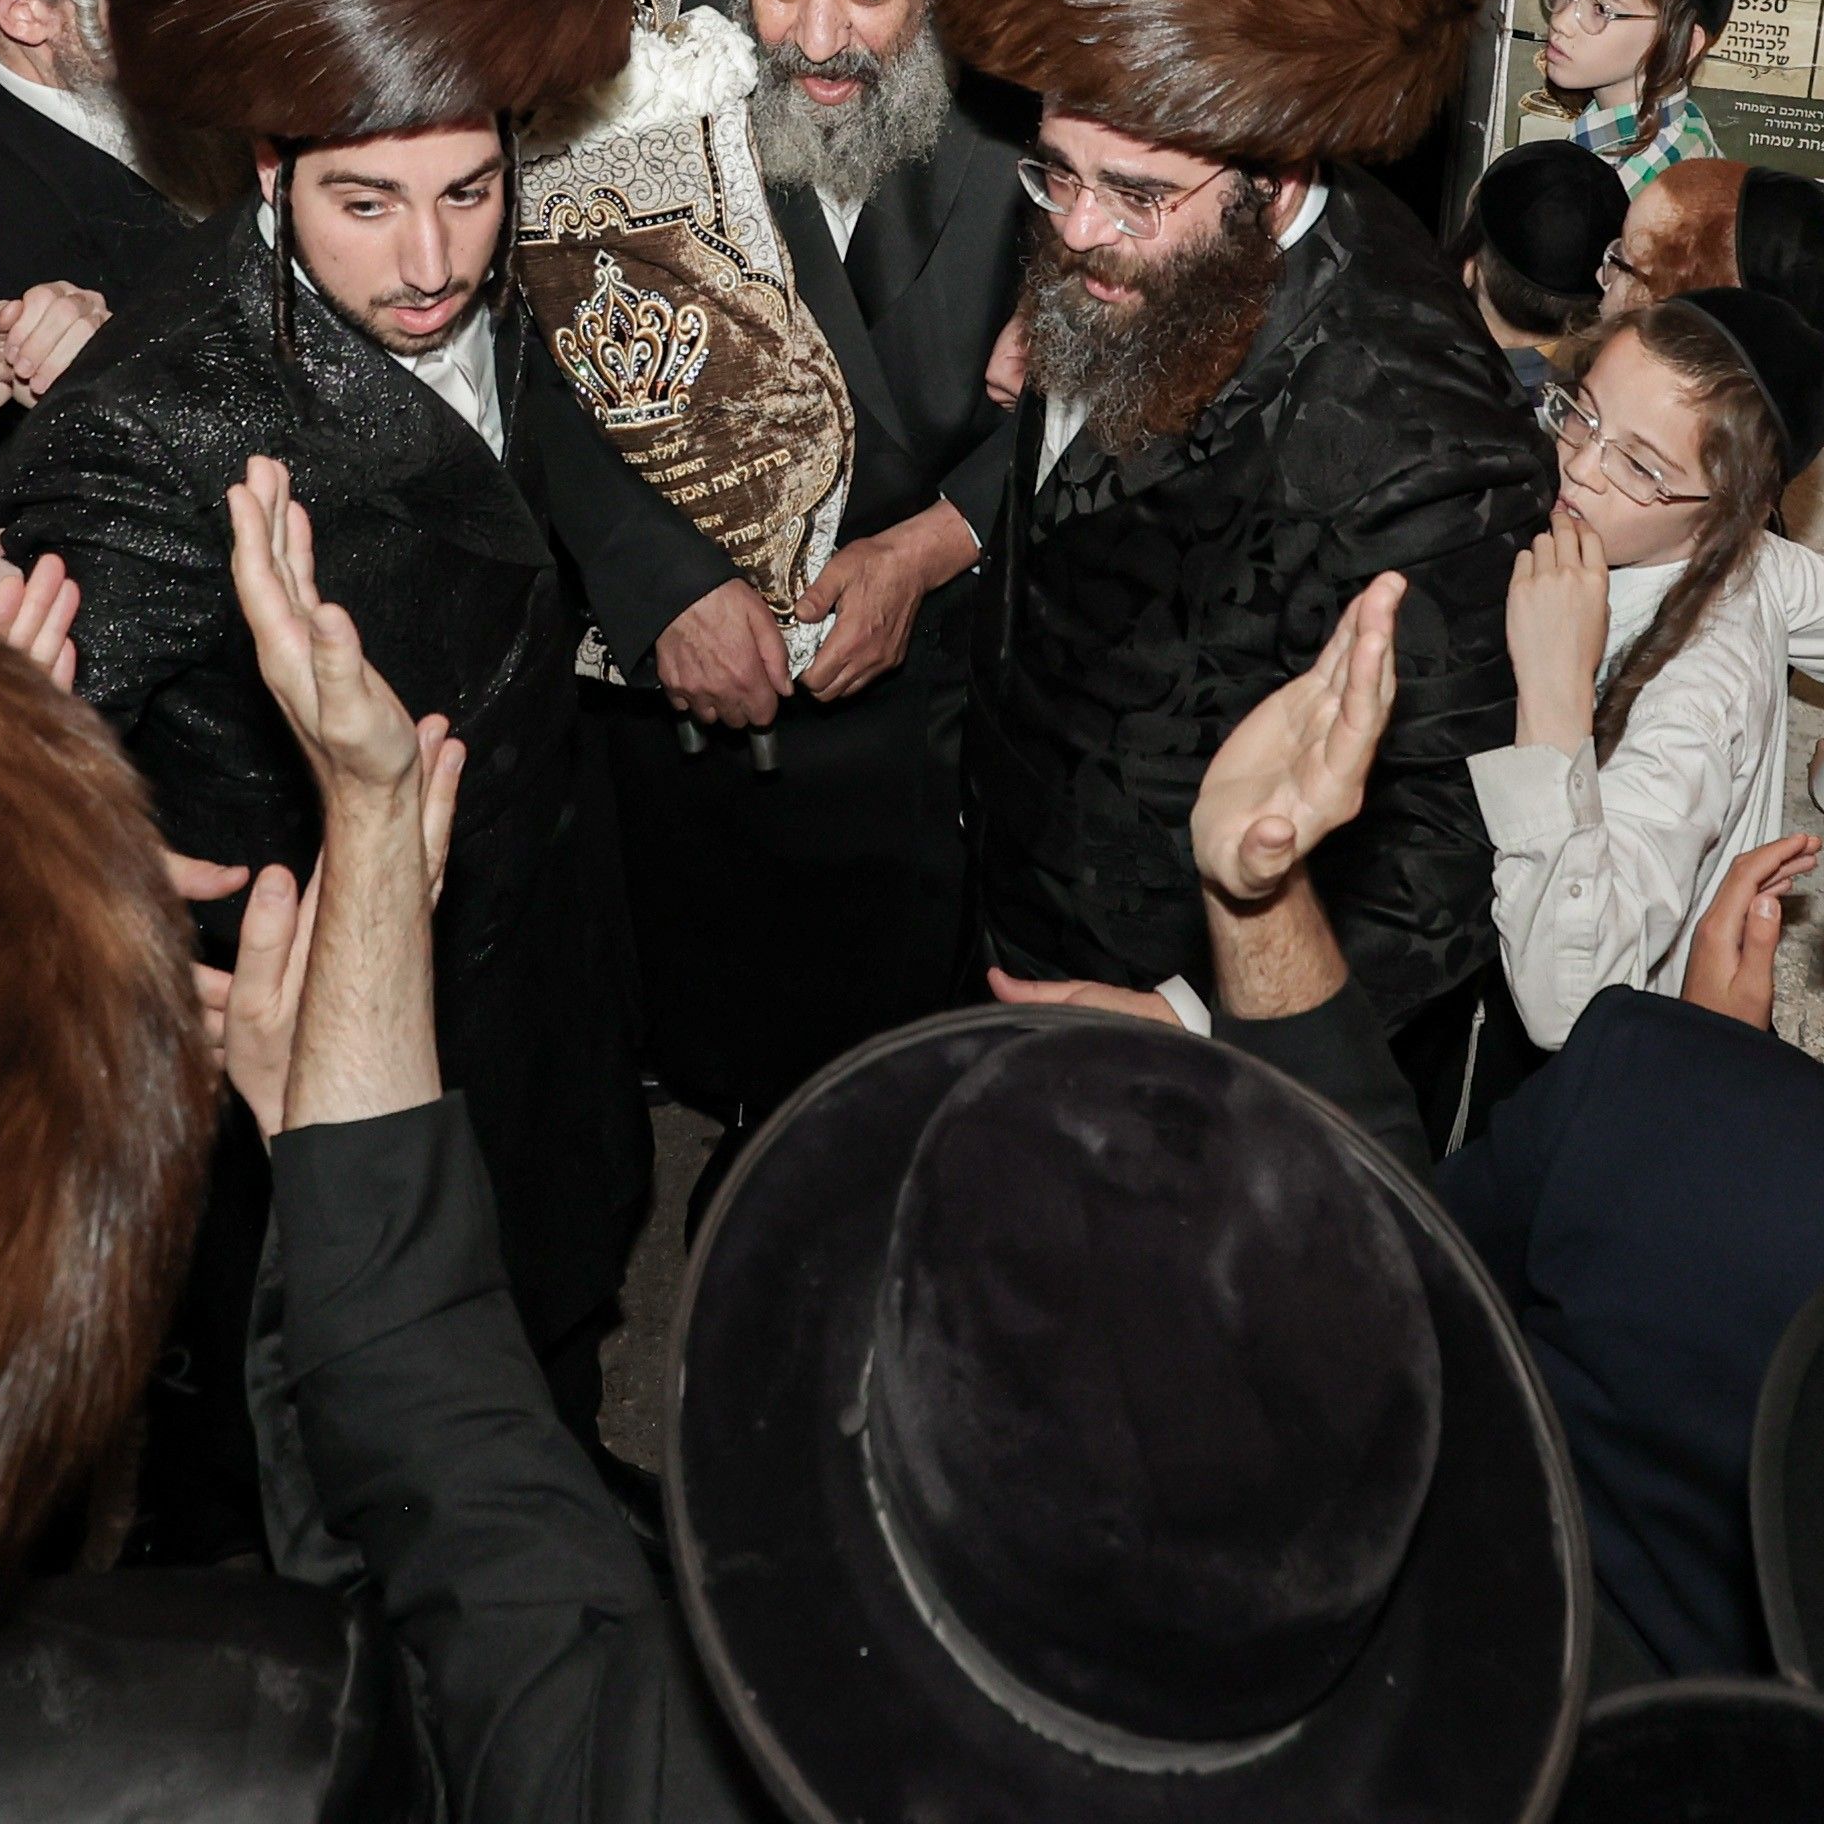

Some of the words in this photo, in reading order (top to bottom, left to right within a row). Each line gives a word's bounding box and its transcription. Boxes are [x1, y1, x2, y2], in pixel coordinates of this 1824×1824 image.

[1727, 20, 1790, 37] תהלוכה
[1727, 35, 1787, 51] לכבודה
[1720, 49, 1760, 63] תורה
[1766, 51, 1790, 66] של
[1734, 101, 1776, 115] בשמחה
[1764, 118, 1802, 131] התורה
[1748, 132, 1794, 148] שמחון
[711, 459, 750, 494] לאה
